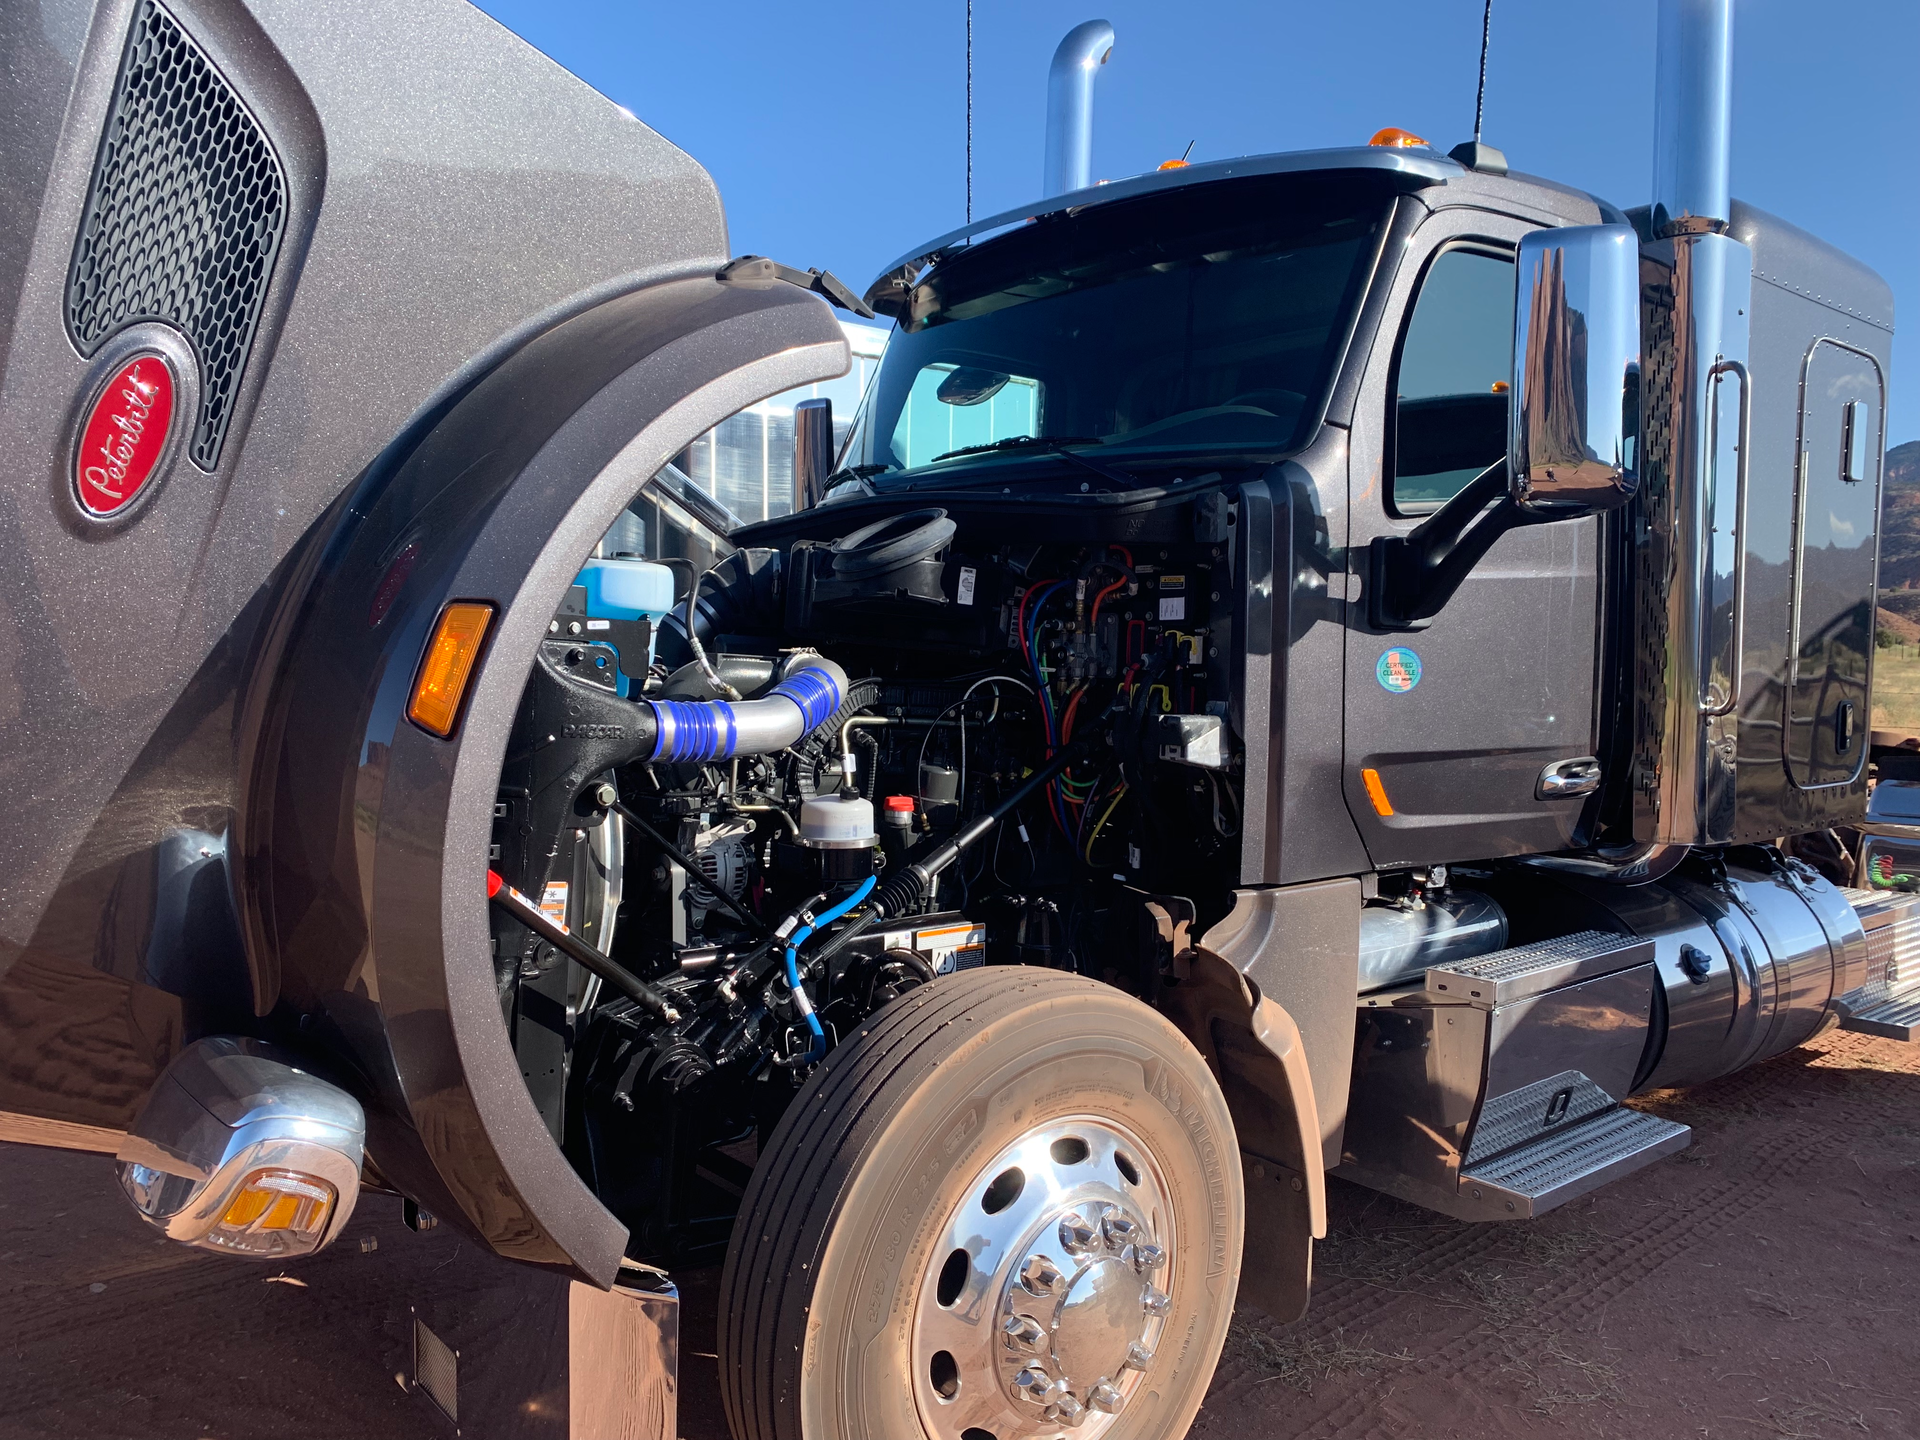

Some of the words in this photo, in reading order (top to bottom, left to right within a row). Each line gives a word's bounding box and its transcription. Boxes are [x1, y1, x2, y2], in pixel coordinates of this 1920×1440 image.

[85, 365, 159, 499] Peterbilt
[561, 723, 625, 740] PACCAR
[1183, 1104, 1226, 1272] MICHELIN
[867, 1230, 902, 1324] 275/80
[899, 1205, 914, 1230] R
[1177, 1312, 1198, 1362] MICHELIN
